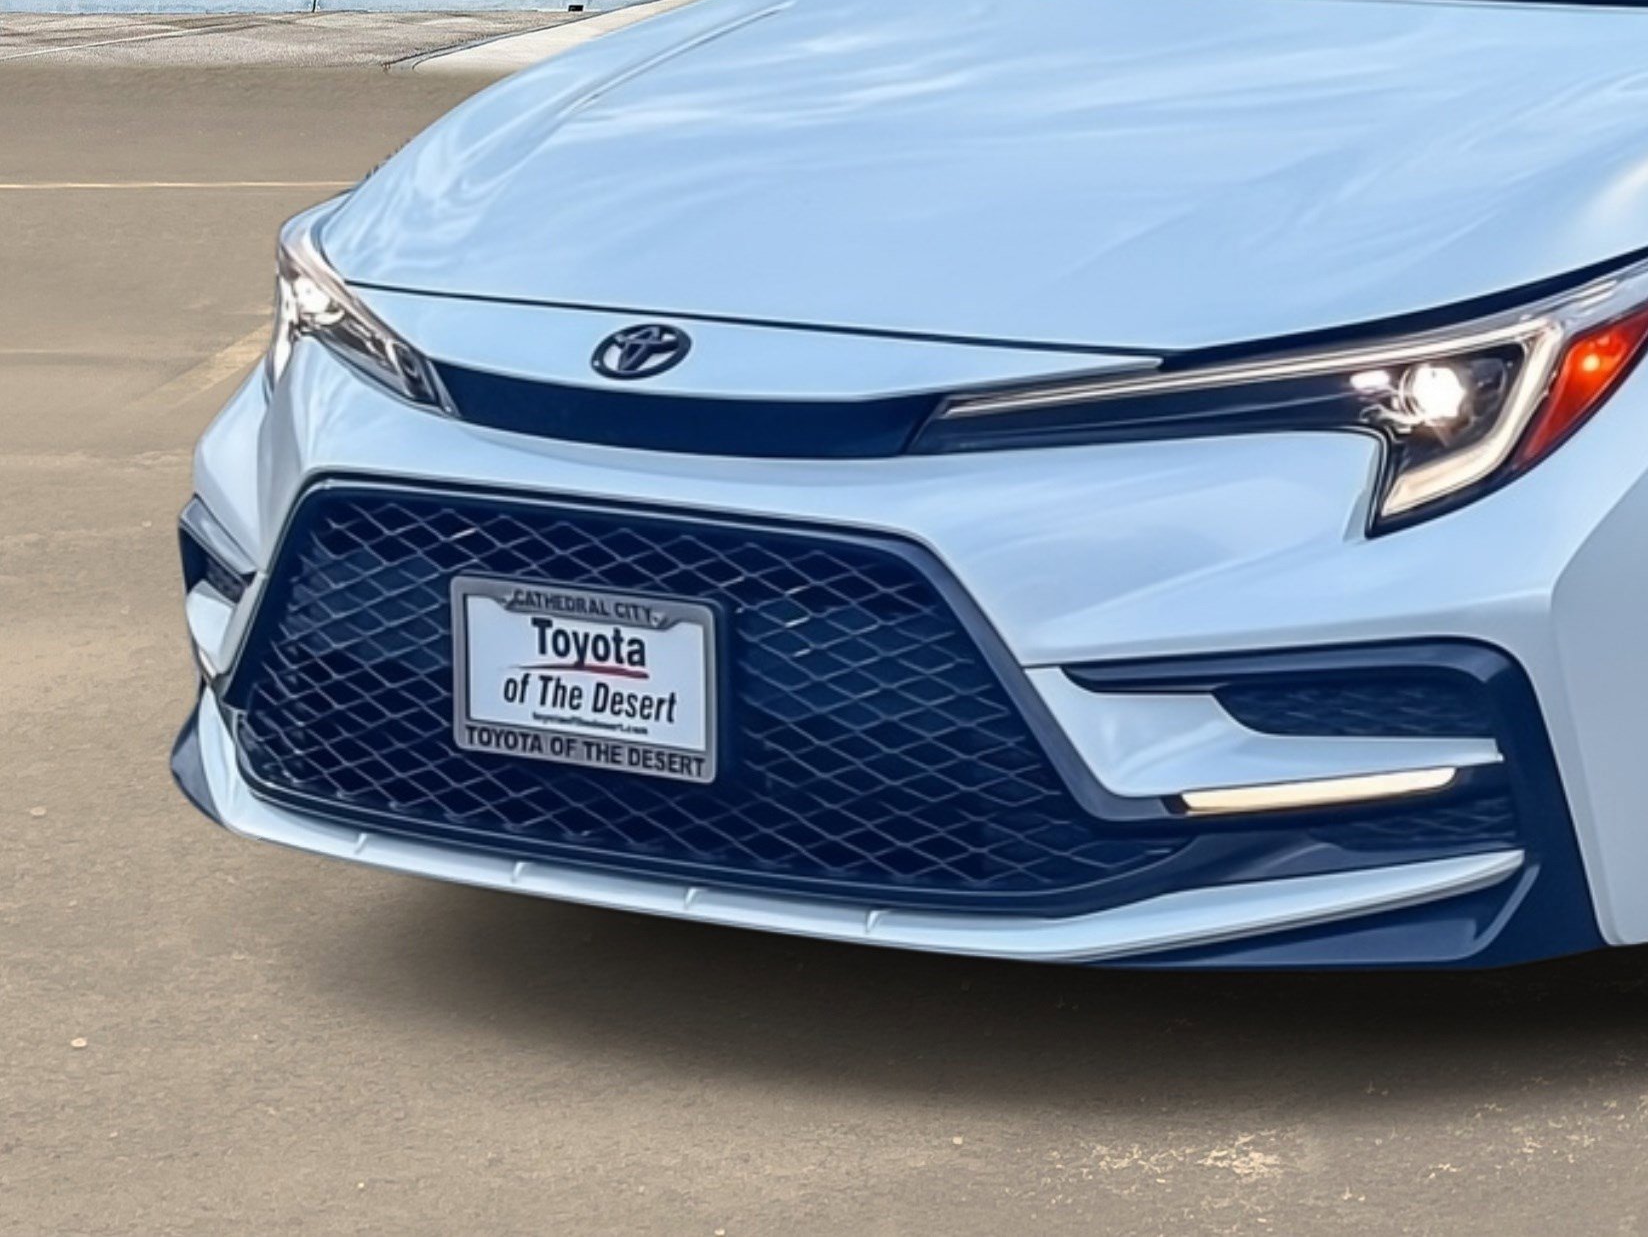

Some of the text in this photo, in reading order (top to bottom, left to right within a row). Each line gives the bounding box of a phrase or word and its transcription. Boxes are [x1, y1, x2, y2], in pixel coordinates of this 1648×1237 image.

[513, 588, 653, 622] CATHEDRAL CITY
[531, 616, 646, 667] Toyota
[503, 673, 531, 704] of
[537, 674, 583, 710] The
[591, 681, 678, 724] Desert
[465, 724, 706, 778] TOYOTA OF THE DESERT
